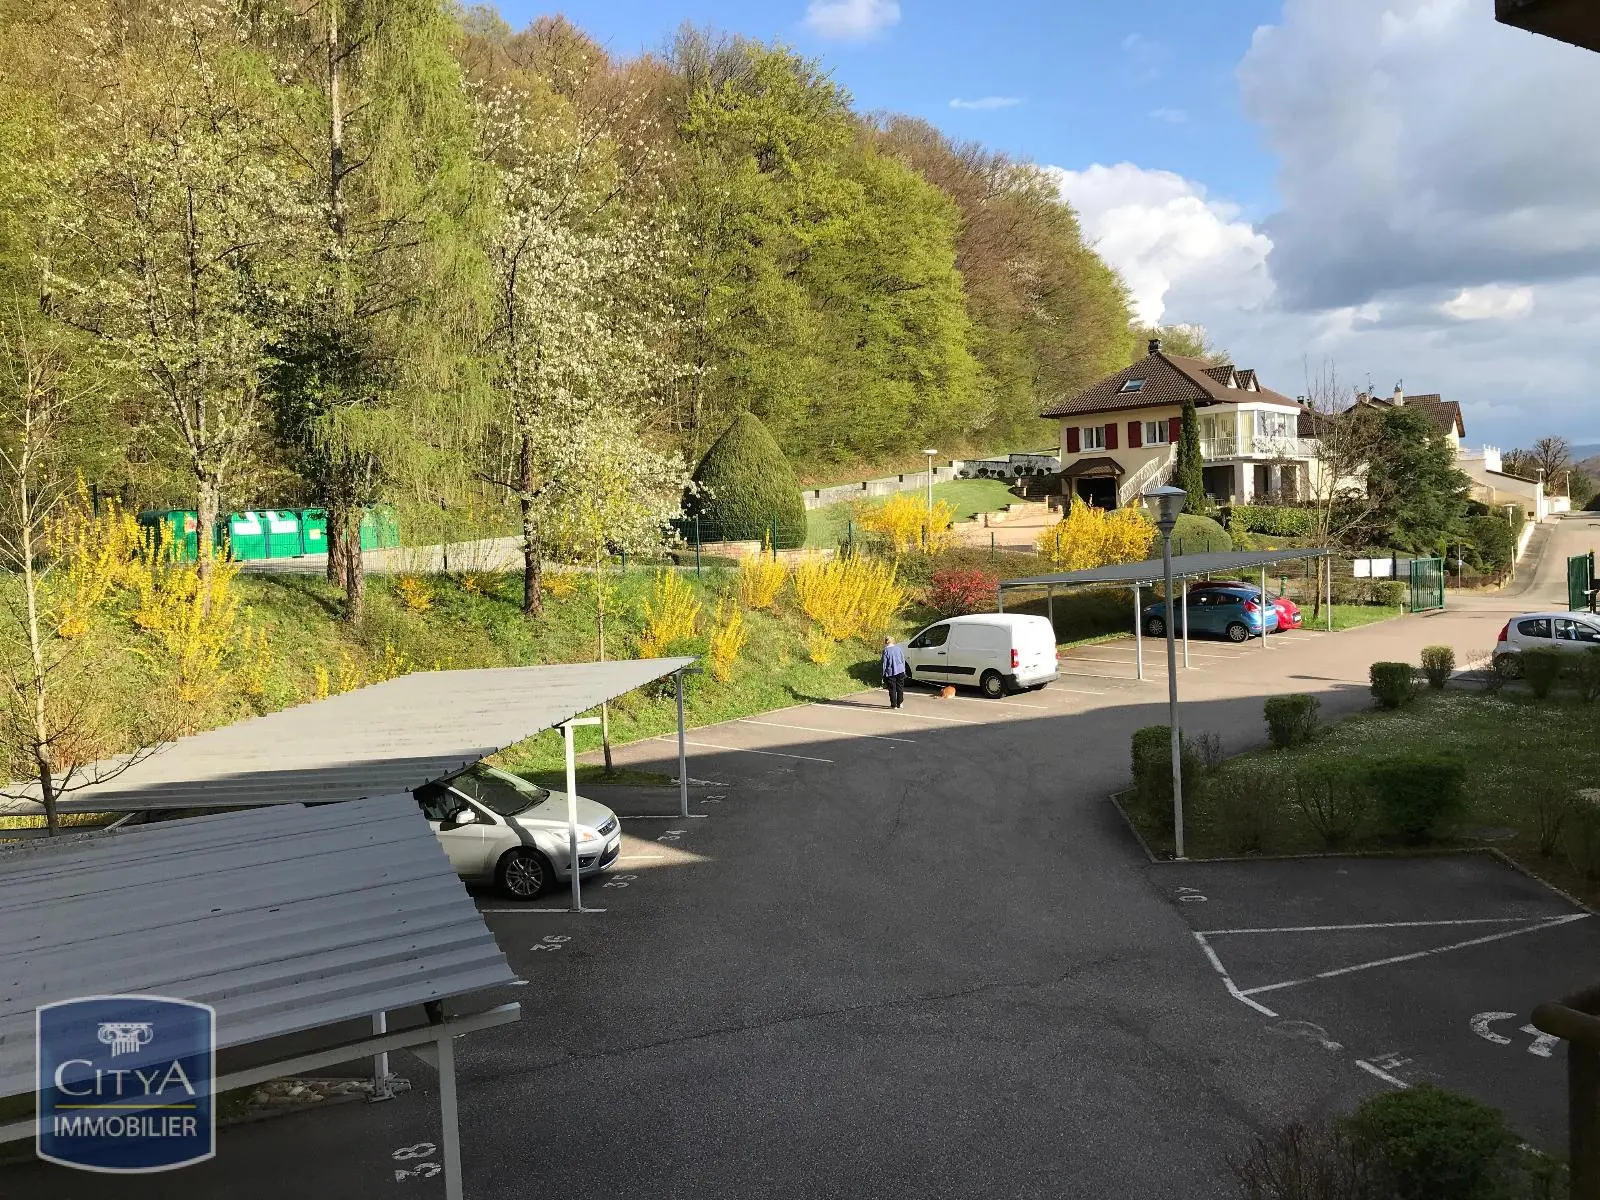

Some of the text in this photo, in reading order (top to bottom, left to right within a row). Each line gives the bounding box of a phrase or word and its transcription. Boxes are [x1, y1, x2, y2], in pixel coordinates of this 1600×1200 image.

[602, 874, 638, 888] 35
[530, 935, 572, 951] 36
[392, 1142, 442, 1182] 38
